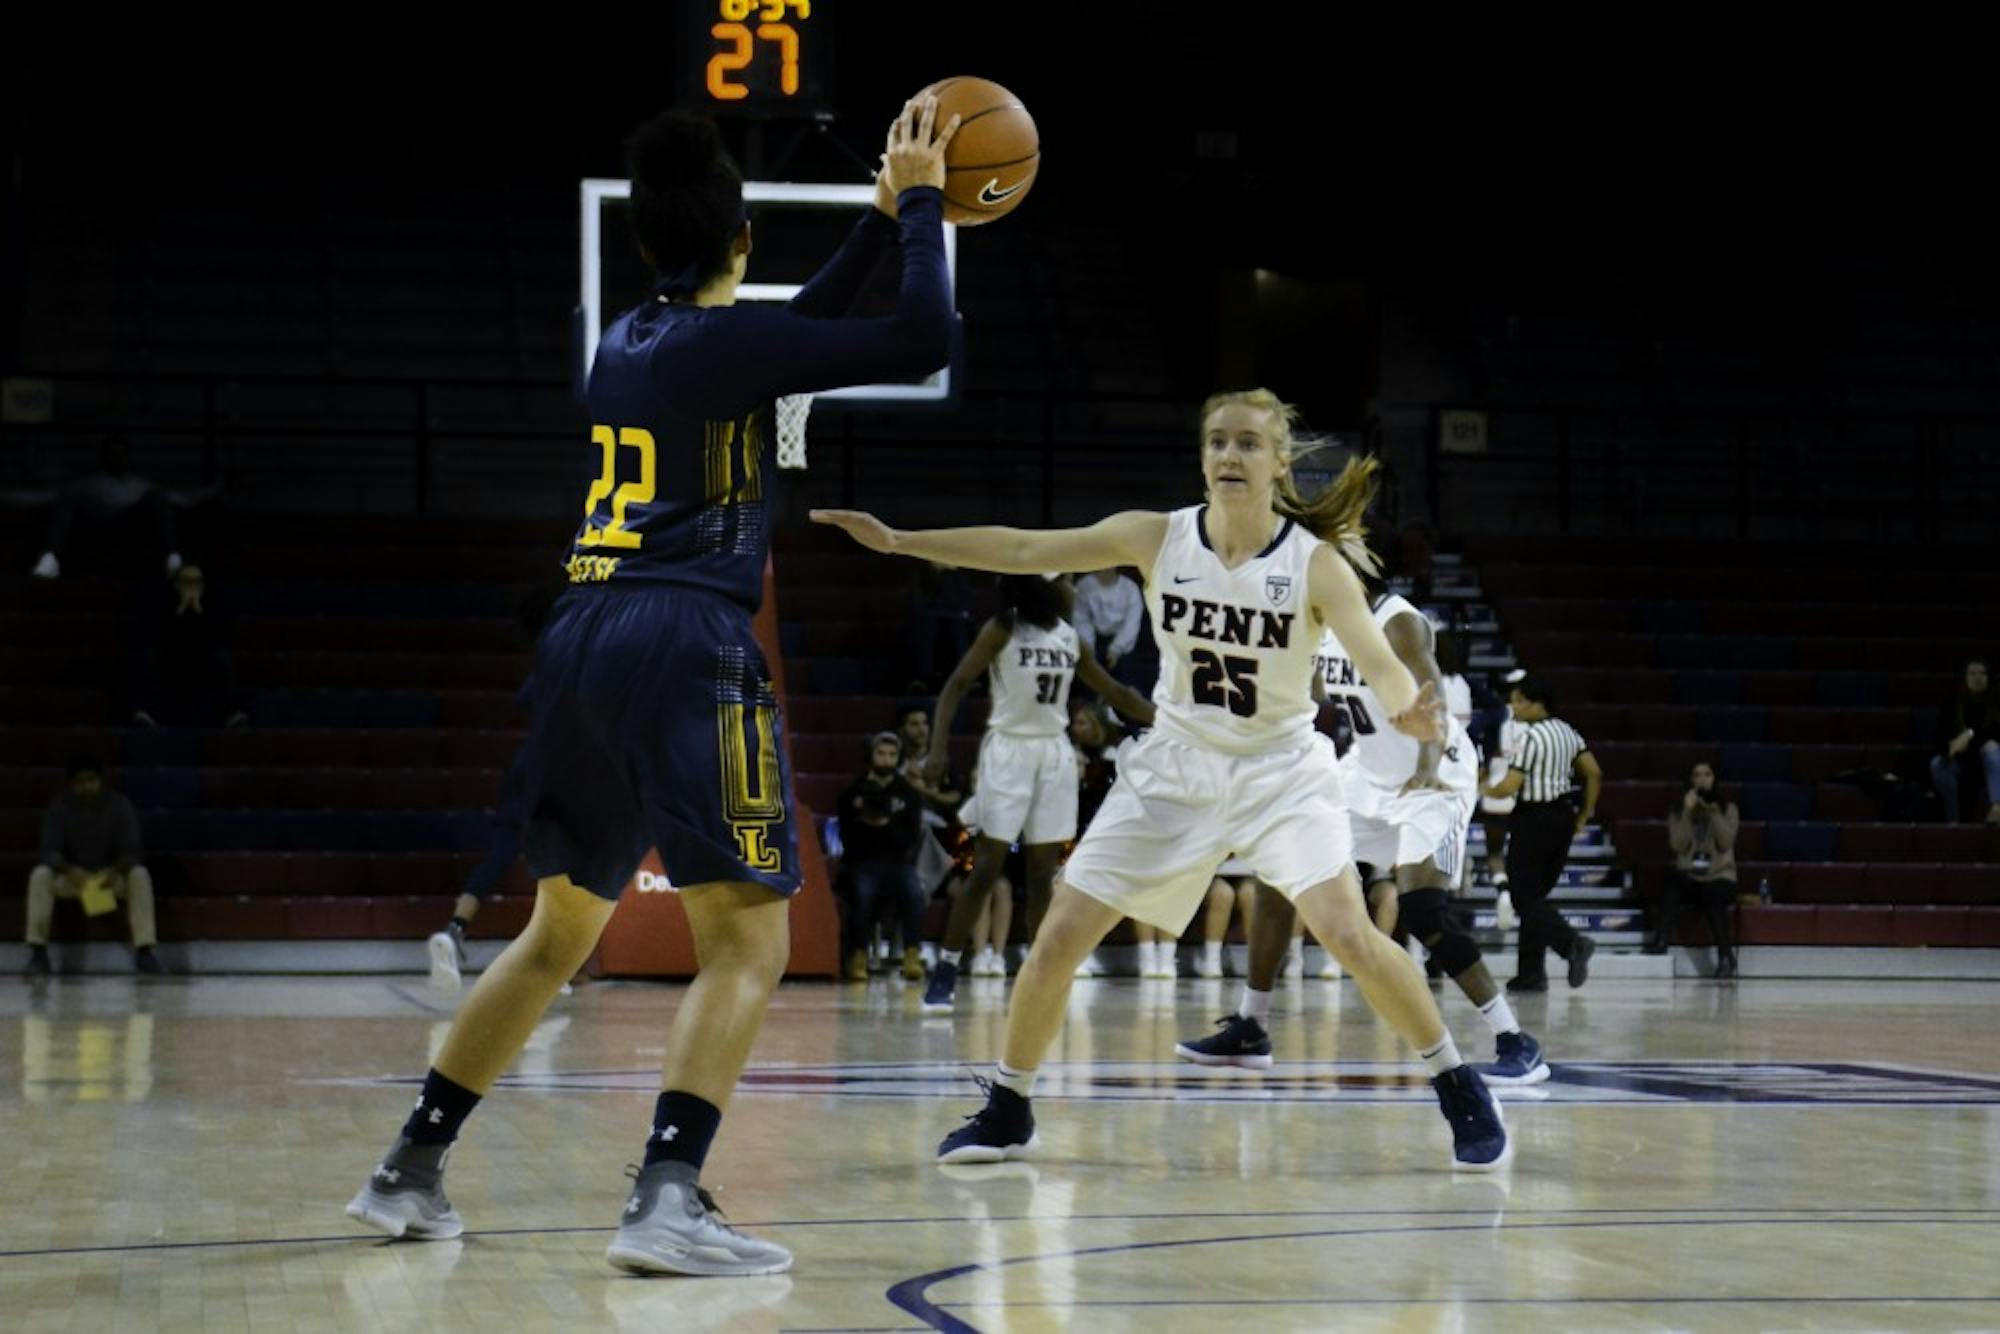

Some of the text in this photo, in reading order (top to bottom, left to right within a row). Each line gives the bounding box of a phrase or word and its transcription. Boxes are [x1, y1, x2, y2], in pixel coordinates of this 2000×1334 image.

[707, 22, 799, 100] 27
[576, 424, 656, 549] 22
[1162, 593, 1295, 648] PENN
[1036, 673, 1063, 704] 31
[1191, 648, 1258, 718] 25
[1311, 655, 1366, 686] PEN
